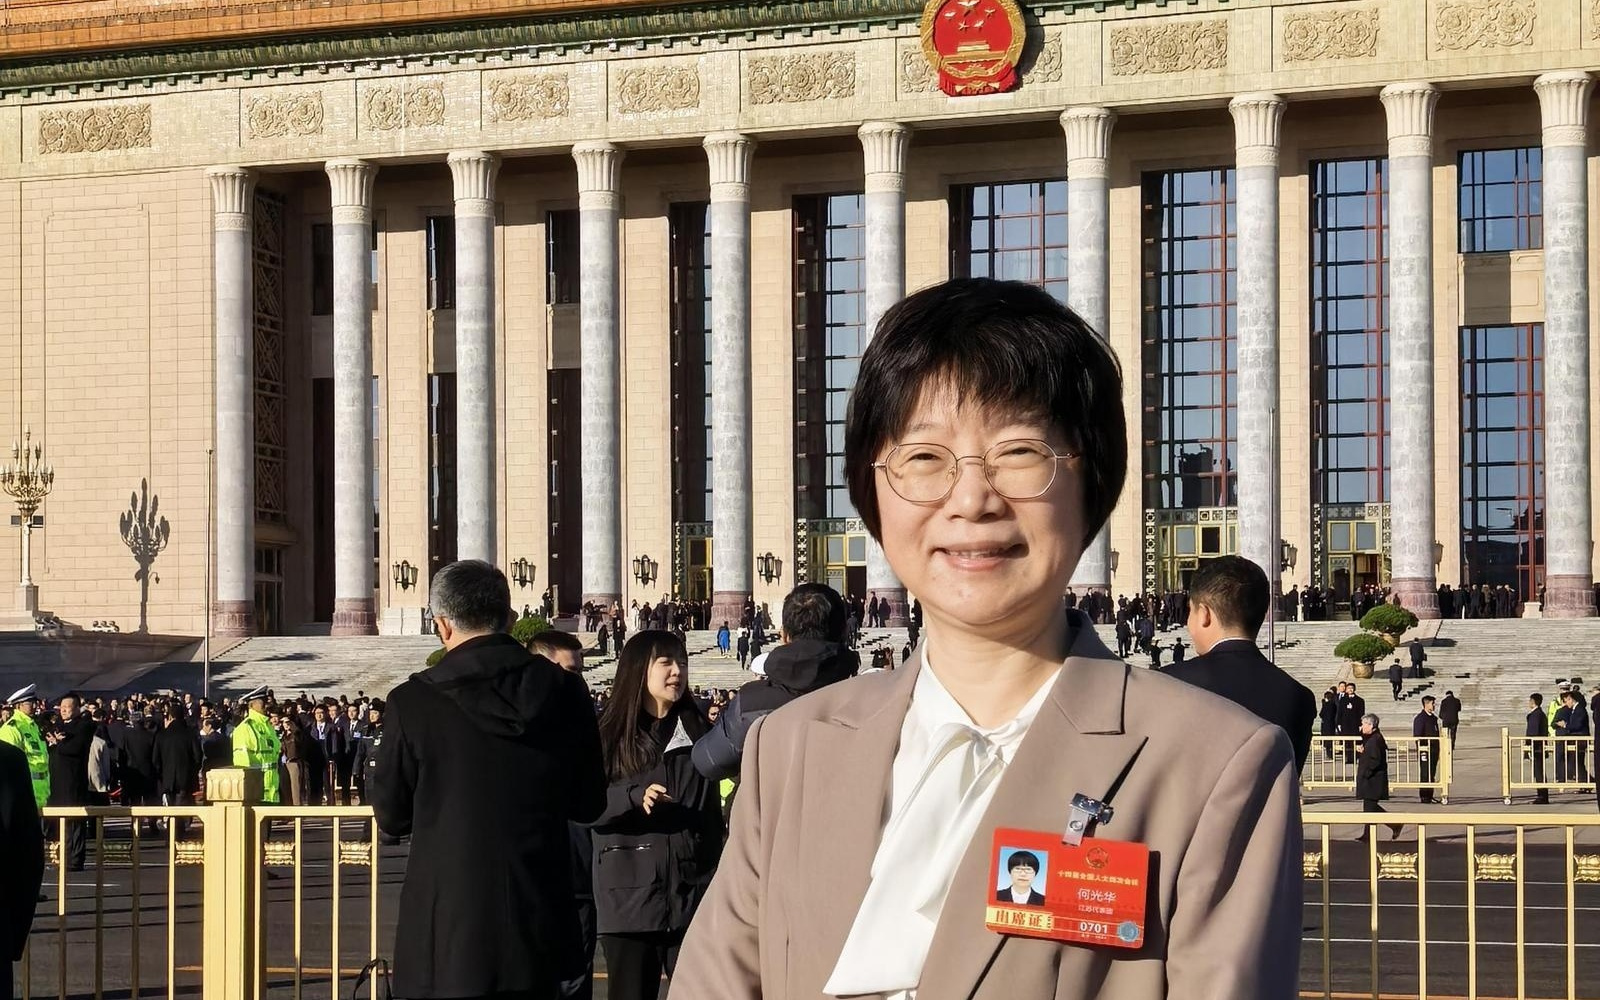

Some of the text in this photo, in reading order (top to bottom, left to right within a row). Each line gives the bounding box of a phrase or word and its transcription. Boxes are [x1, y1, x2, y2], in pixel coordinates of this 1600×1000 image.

[1077, 888, 1117, 904] 何光华
[995, 909, 1042, 928] 出席证
[1080, 922, 1108, 934] 0701
